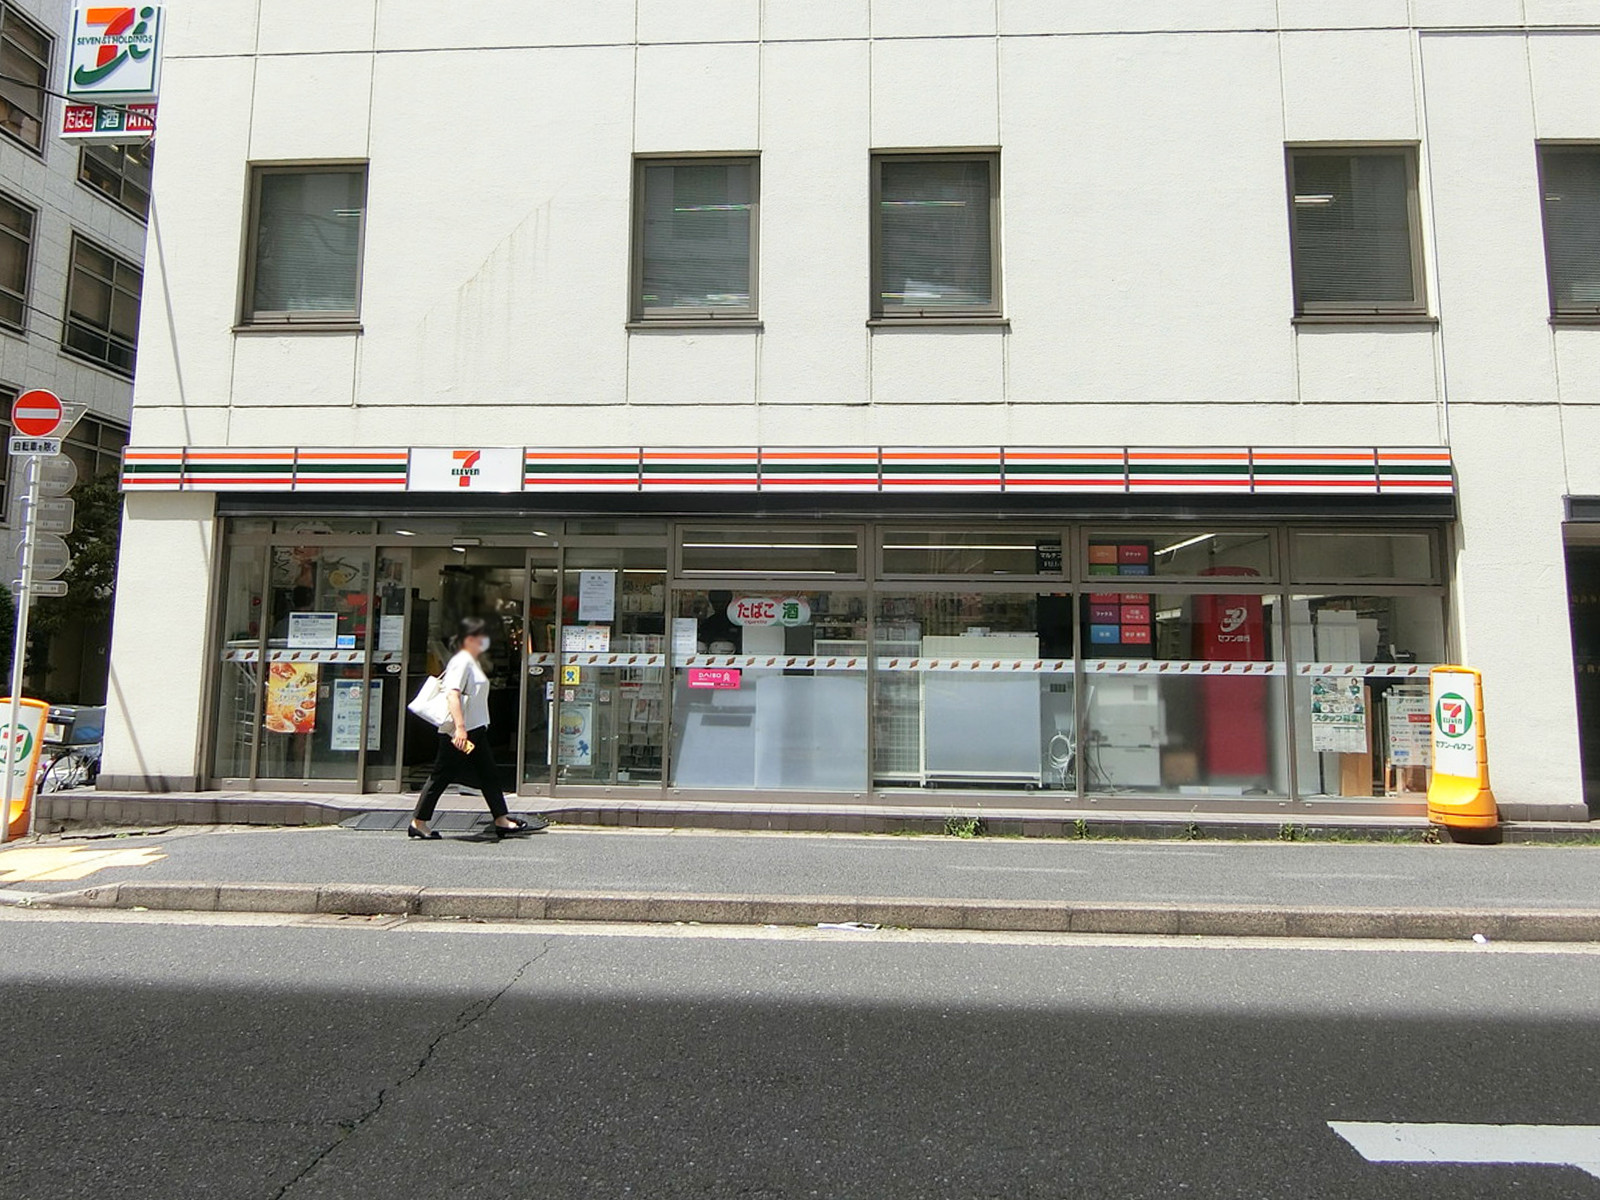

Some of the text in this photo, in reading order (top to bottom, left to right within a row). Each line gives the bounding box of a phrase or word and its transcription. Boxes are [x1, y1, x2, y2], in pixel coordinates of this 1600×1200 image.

[77, 37, 100, 45] SEVEN
[112, 35, 153, 44] HOLDINGS
[66, 111, 93, 128] たばこ
[101, 109, 119, 128] 酒
[737, 602, 799, 619] たばこ 酒
